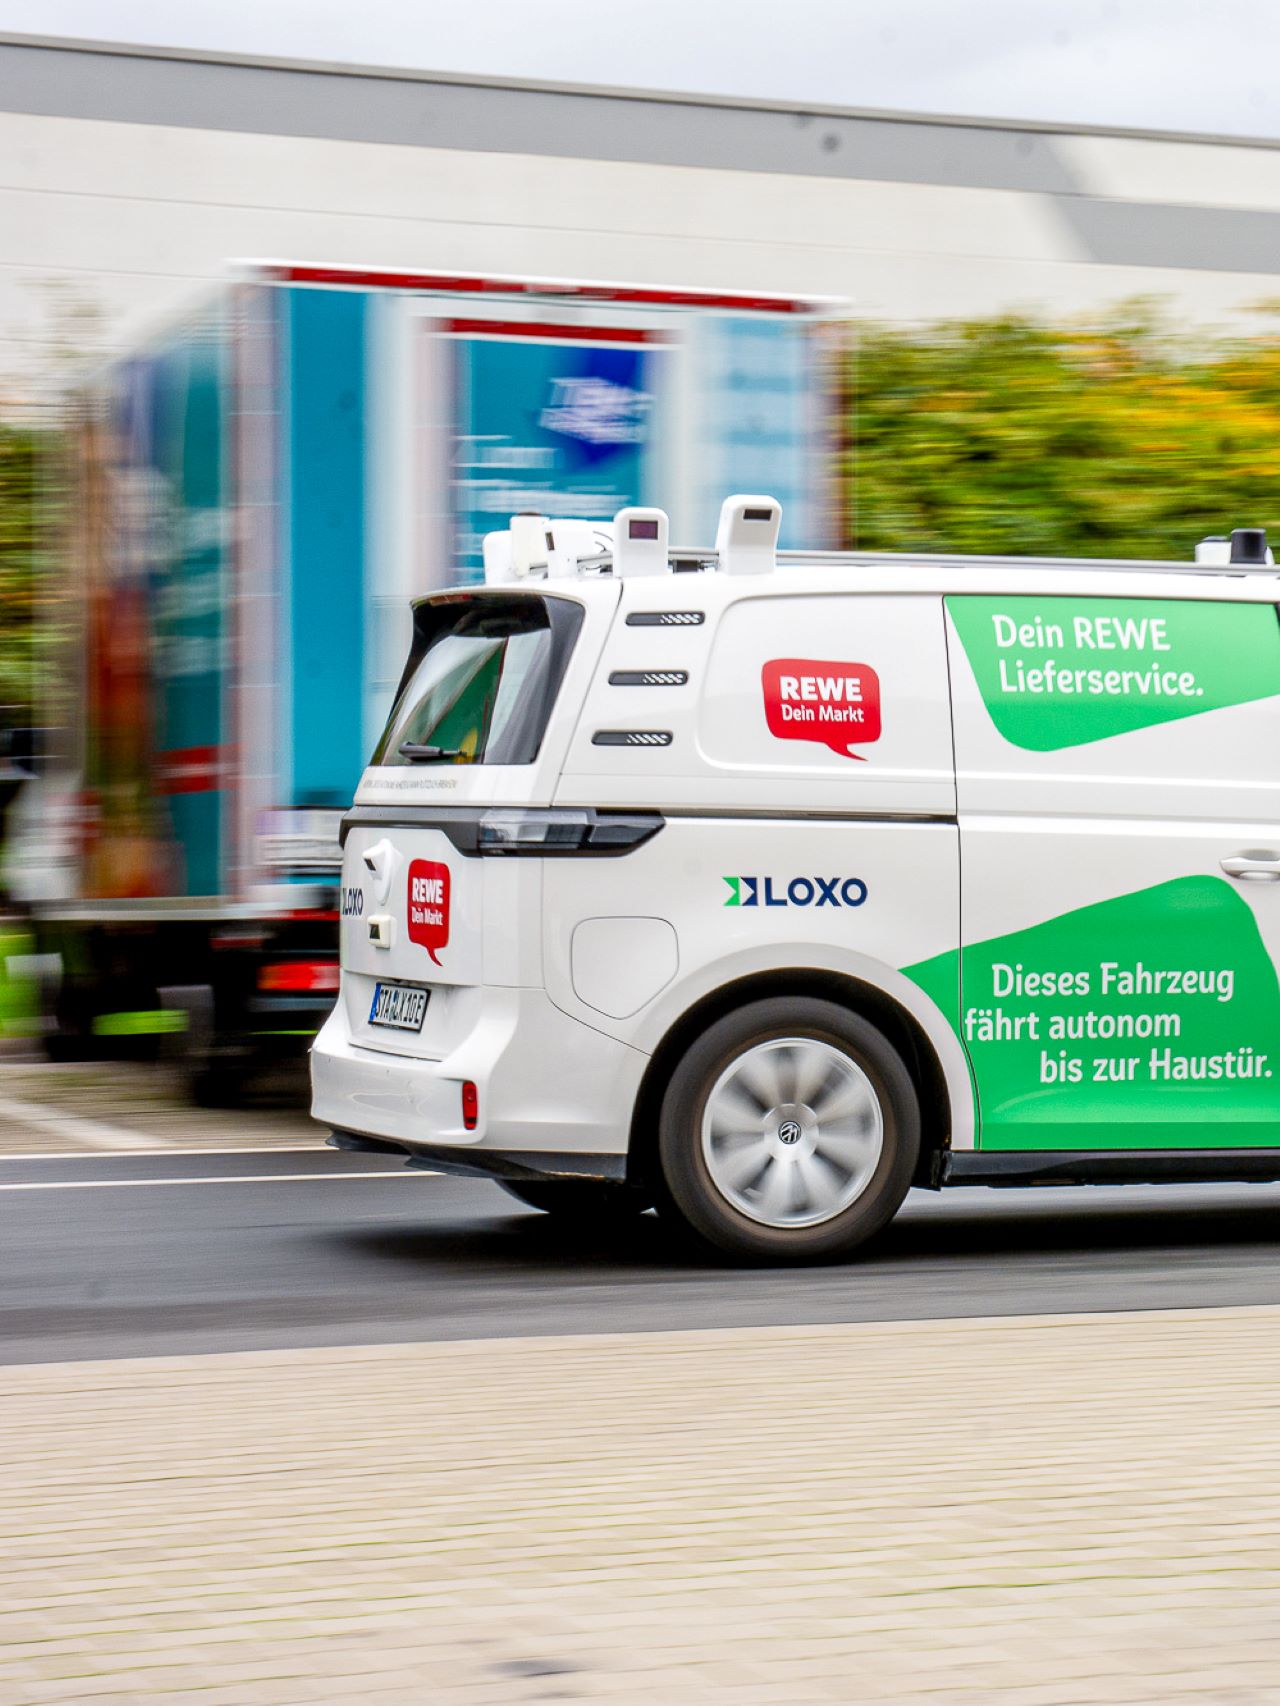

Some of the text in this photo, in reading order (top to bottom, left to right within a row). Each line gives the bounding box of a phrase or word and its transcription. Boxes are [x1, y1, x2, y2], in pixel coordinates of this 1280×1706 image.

[992, 614, 1171, 651] Dein REWE
[780, 676, 863, 702] REWE
[999, 659, 1204, 696] Lieferservice.
[781, 704, 864, 723] Dein Markt
[412, 877, 444, 904] REWE
[764, 877, 868, 907] LOXO
[411, 906, 443, 926] Dein Markt
[992, 962, 1235, 1002] Dieses Fahrzeug
[965, 1008, 1181, 1041] fährt autonom
[1040, 1047, 1273, 1083] bis zur Haustür.
